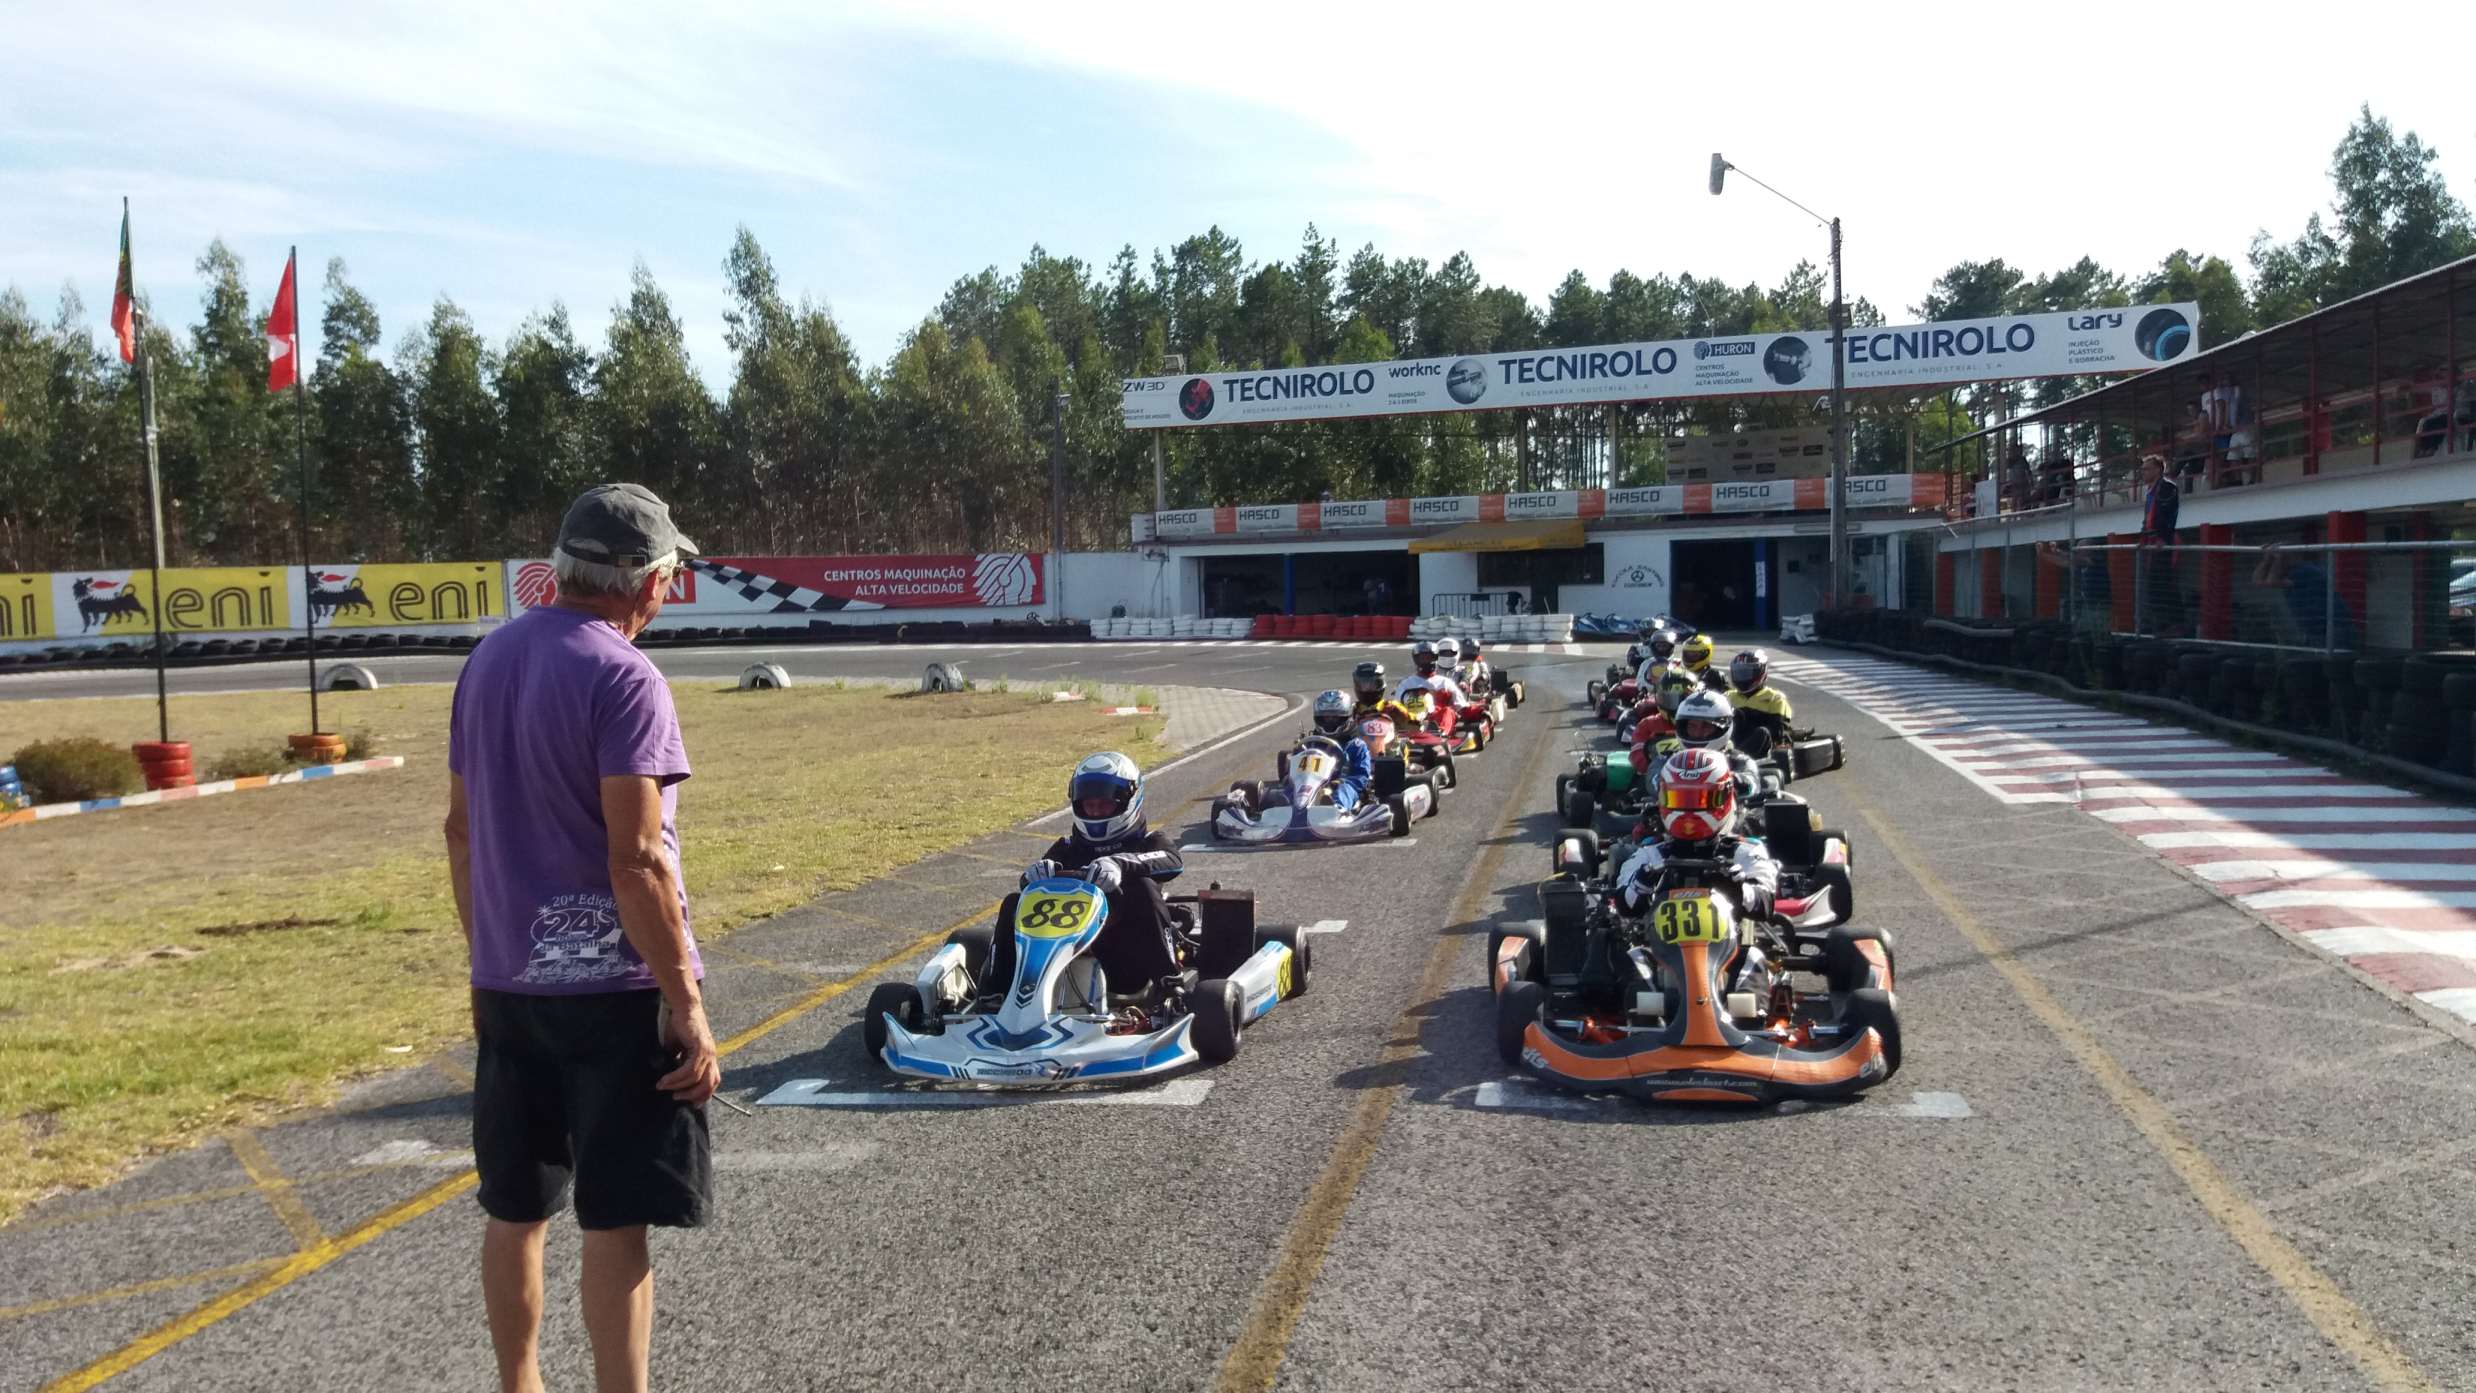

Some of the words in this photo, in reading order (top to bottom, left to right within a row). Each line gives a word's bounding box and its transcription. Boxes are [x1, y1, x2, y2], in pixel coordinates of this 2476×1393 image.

[1714, 343, 1752, 355] HURON
[1388, 362, 1441, 378] worknc
[1498, 348, 1678, 385] TECNIROLO
[1222, 369, 1375, 402] TECNIROLO
[1716, 485, 1770, 499] HASCO
[1846, 479, 1887, 493] ASCO
[1508, 495, 1556, 508] HASCO
[1609, 490, 1660, 504] HASCO
[1324, 504, 1366, 517] HASCO
[1413, 501, 1459, 513] HASCO
[1158, 512, 1197, 525] HASCO
[1239, 508, 1279, 521] HASCO
[824, 569, 881, 582] CENTROS
[884, 566, 966, 581] MAQUINAÇÃO
[389, 566, 489, 621] eni
[855, 584, 887, 596] ALTA
[889, 583, 965, 595] VELOCIDADE
[166, 571, 273, 629] eni
[1367, 722, 1382, 734] 83
[1298, 756, 1322, 773] 41
[1021, 899, 1089, 928] 88
[1661, 900, 1720, 941] 331
[544, 910, 600, 942] 24
